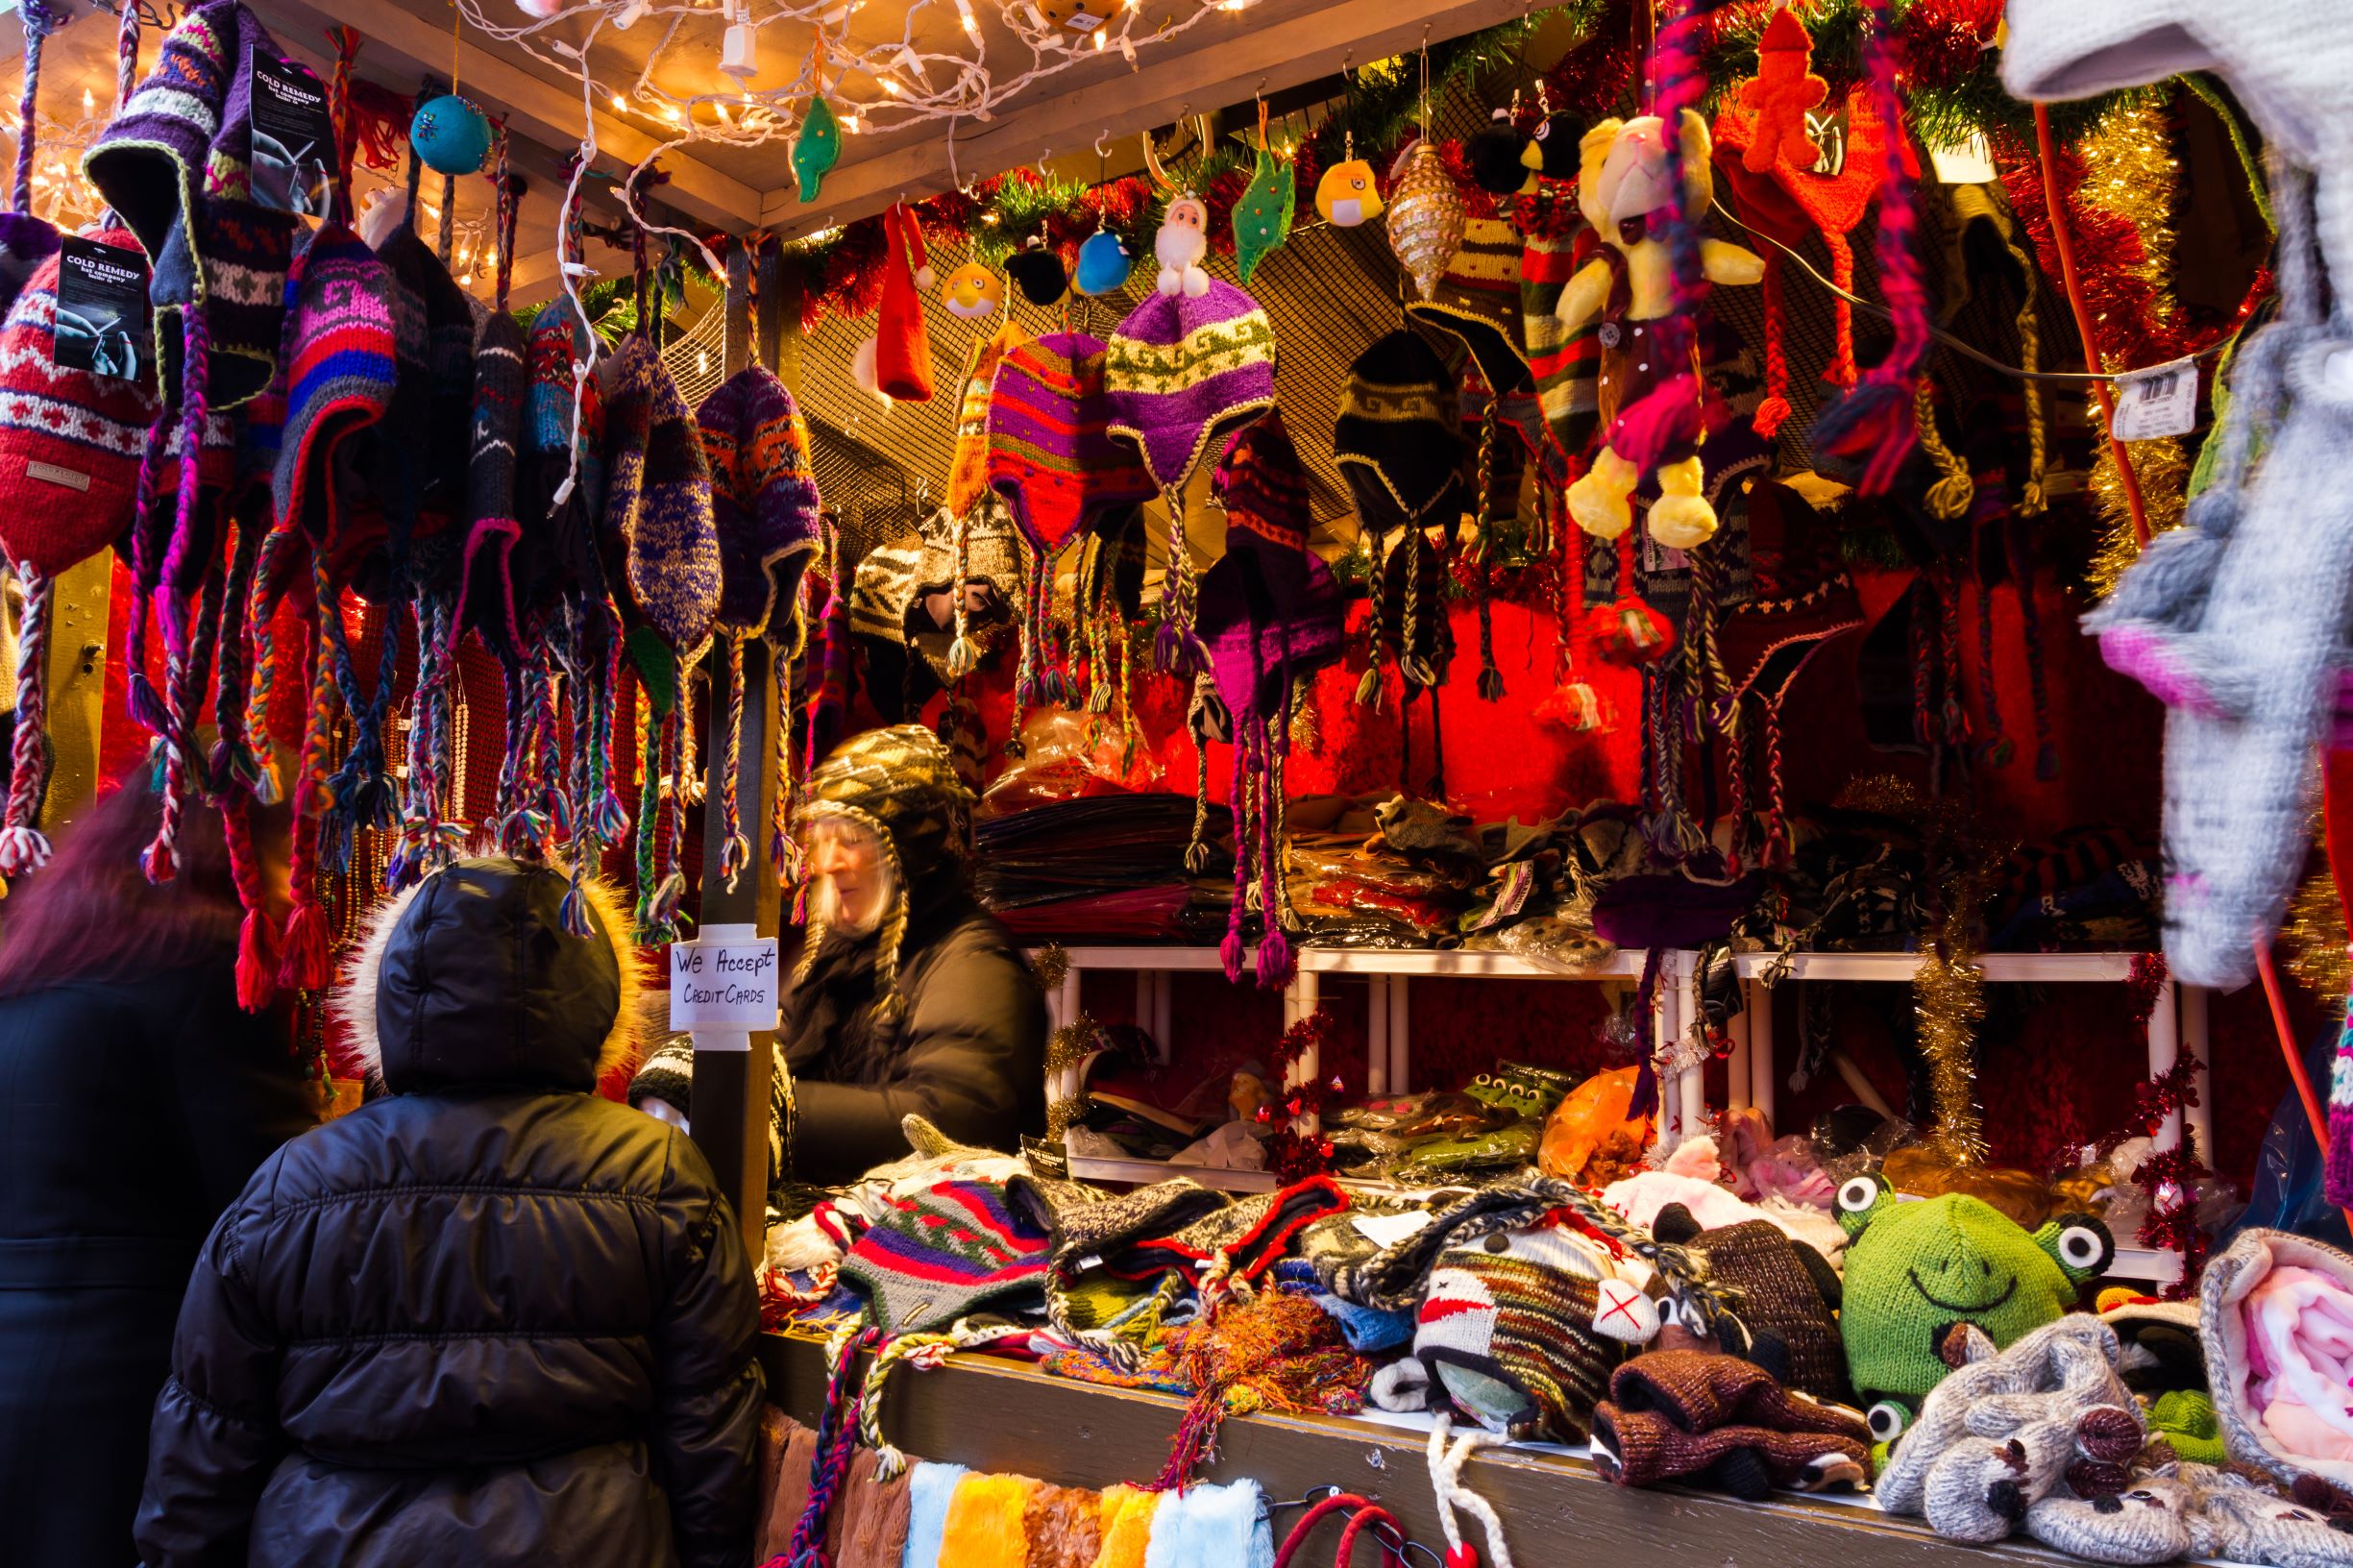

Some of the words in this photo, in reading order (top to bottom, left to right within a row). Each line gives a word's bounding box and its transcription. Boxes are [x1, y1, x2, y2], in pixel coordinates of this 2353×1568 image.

[257, 70, 280, 88] COLD
[282, 84, 321, 103] REMEDY
[280, 90, 309, 105] company
[66, 255, 95, 269] COLD
[98, 262, 140, 280] REMEDY
[94, 270, 126, 283] company
[675, 947, 702, 974] We
[716, 947, 775, 977] Accept
[683, 983, 724, 1004] CREDIT
[725, 983, 765, 1004] CARDS
